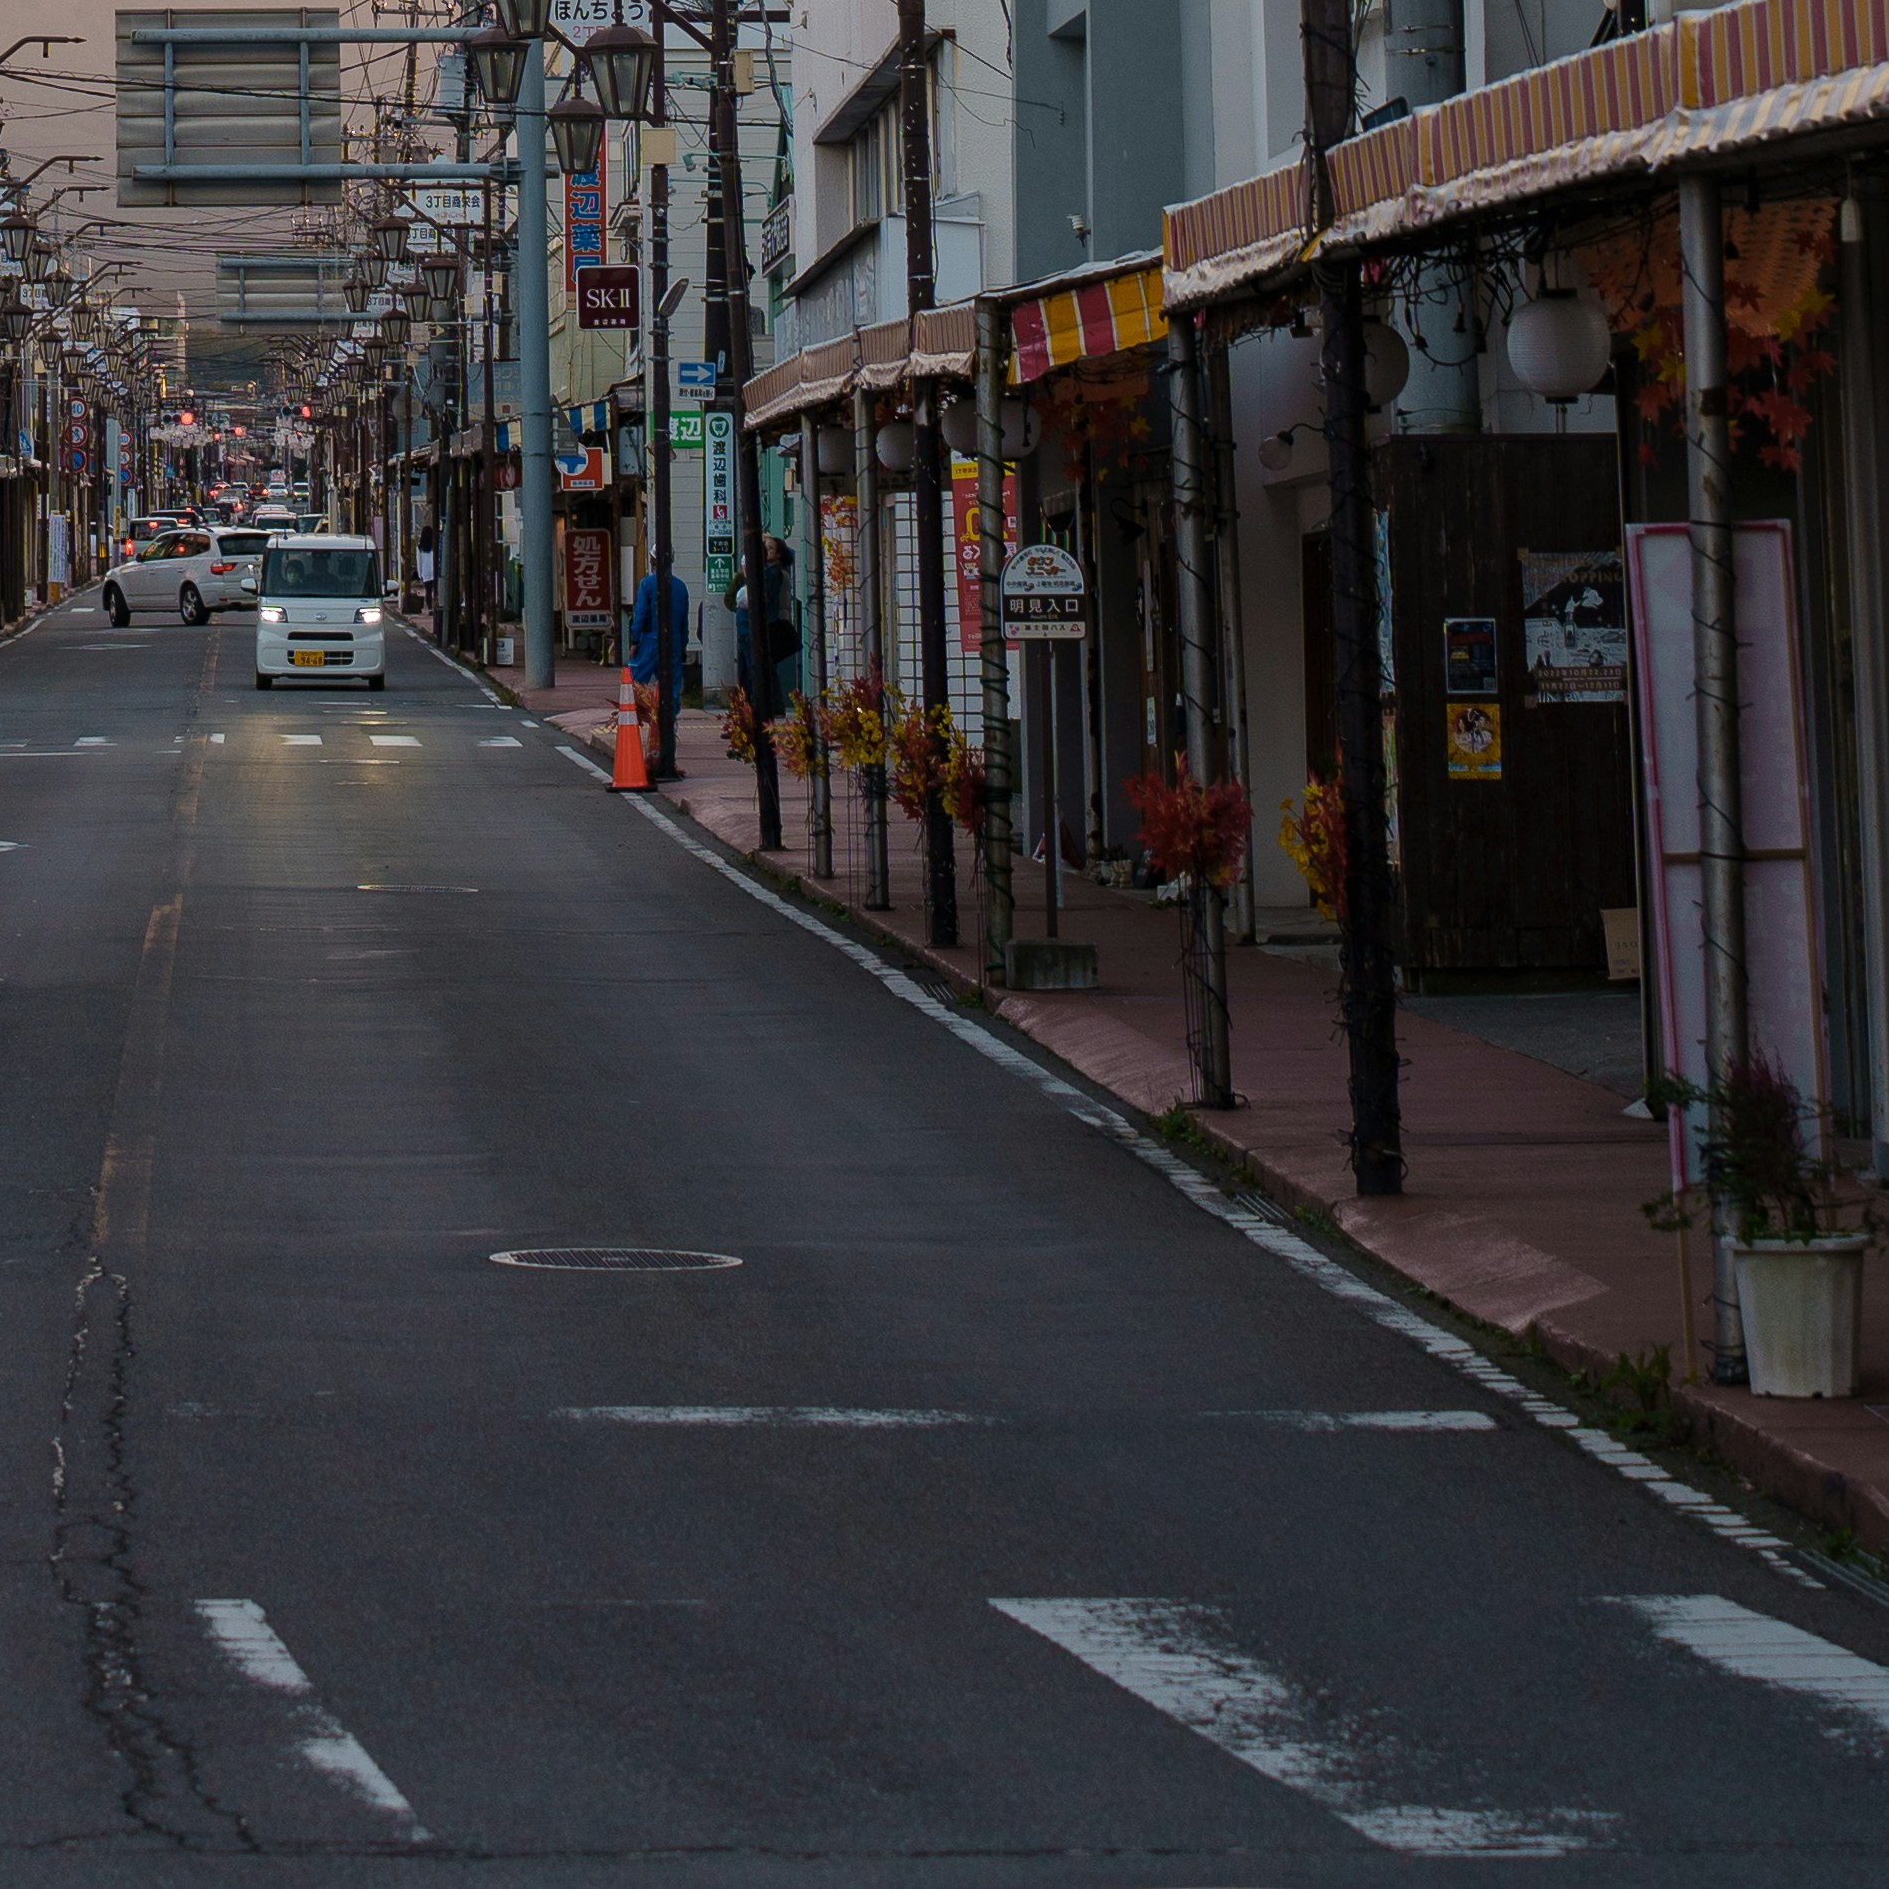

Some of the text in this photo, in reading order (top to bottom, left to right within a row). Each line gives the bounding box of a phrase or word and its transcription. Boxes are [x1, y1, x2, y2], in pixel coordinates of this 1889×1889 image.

[586, 288, 631, 309] SK-II
[713, 441, 727, 504] 渡辺歯科
[573, 536, 602, 607] 処方せん
[1009, 599, 1079, 614] 明見入口
